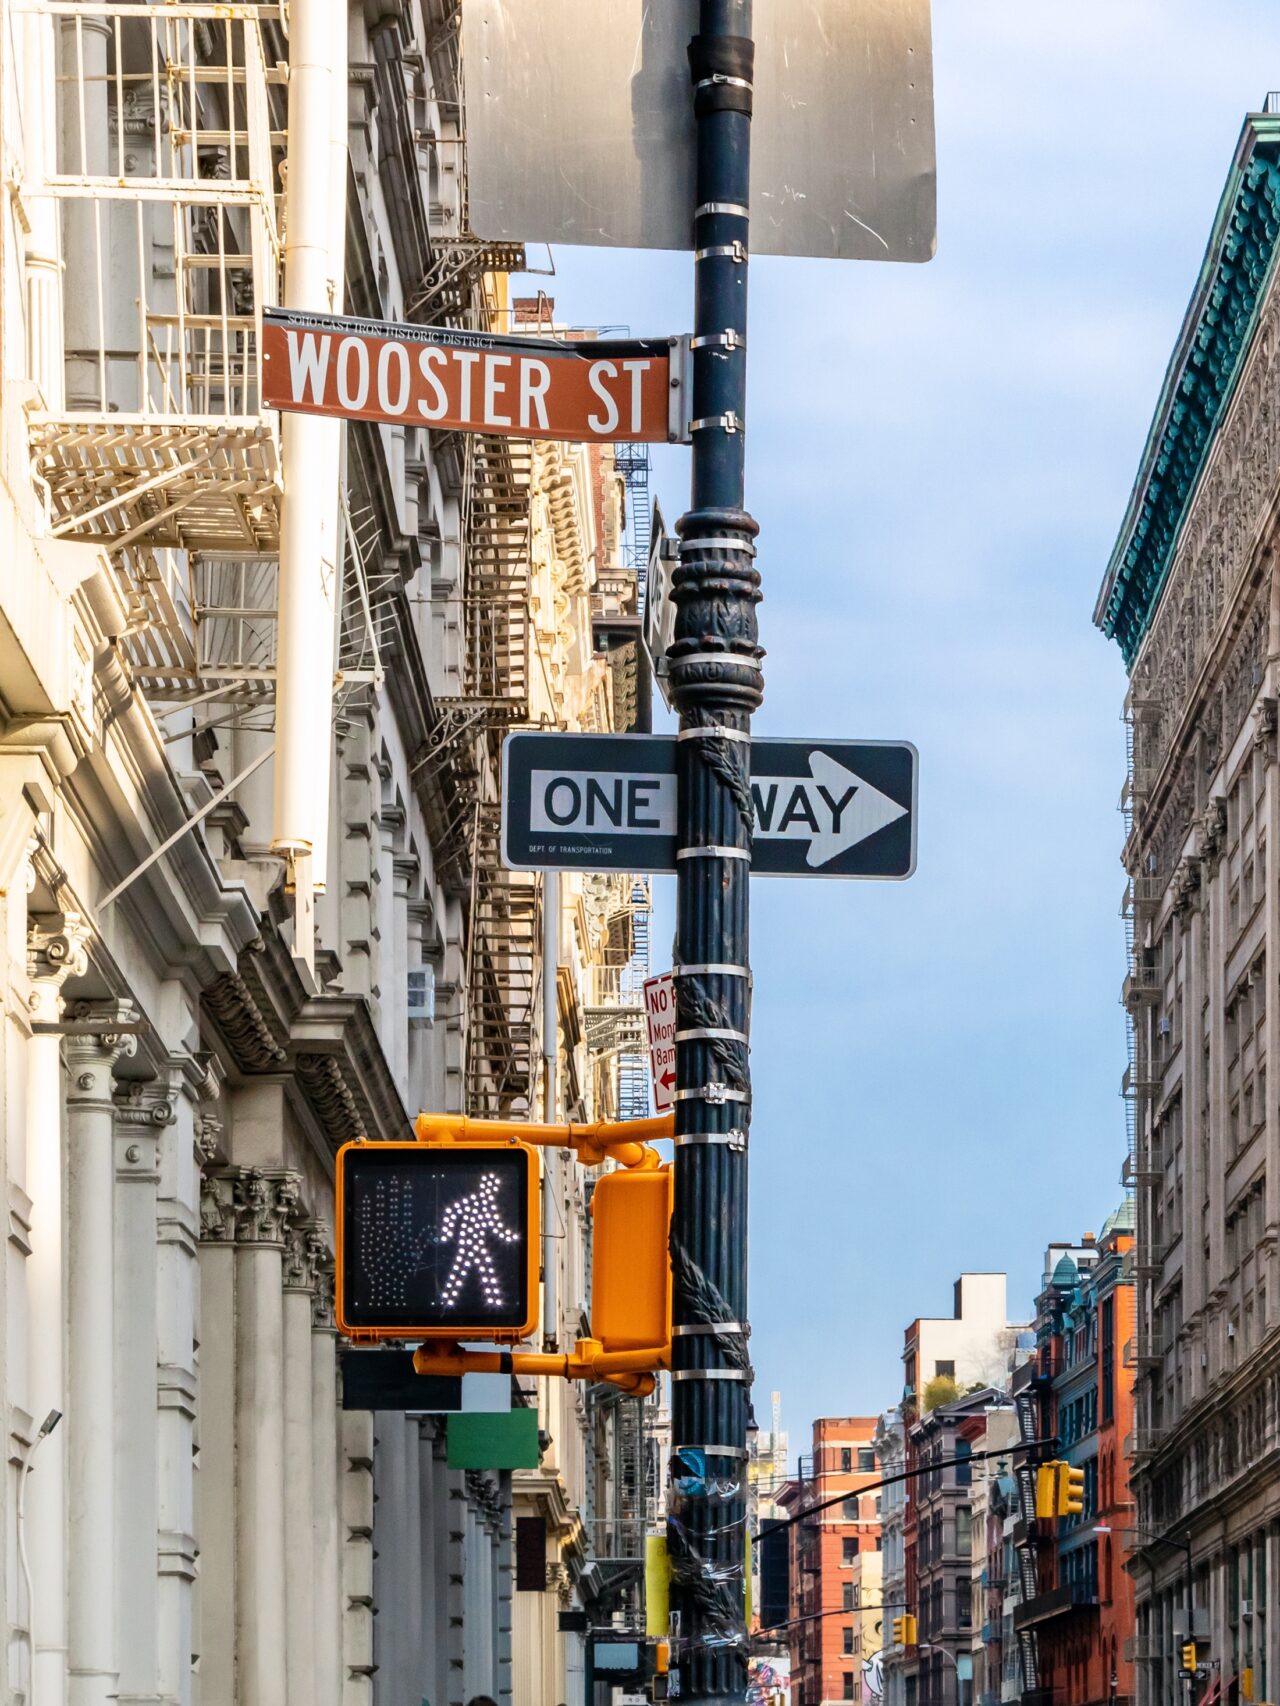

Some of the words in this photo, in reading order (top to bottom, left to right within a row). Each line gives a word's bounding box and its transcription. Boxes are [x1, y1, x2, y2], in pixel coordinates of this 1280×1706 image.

[354, 322, 382, 337] IRON
[385, 326, 440, 343] HISTORIC
[442, 333, 495, 349] DISTRICT
[286, 330, 551, 430] WOOSTER
[587, 359, 651, 434] ST
[543, 776, 661, 828] ONE
[548, 845, 557, 853] OF
[559, 845, 612, 854] TRANSPORTATION
[650, 988, 668, 1015] NO
[656, 1047, 676, 1066] 8am
